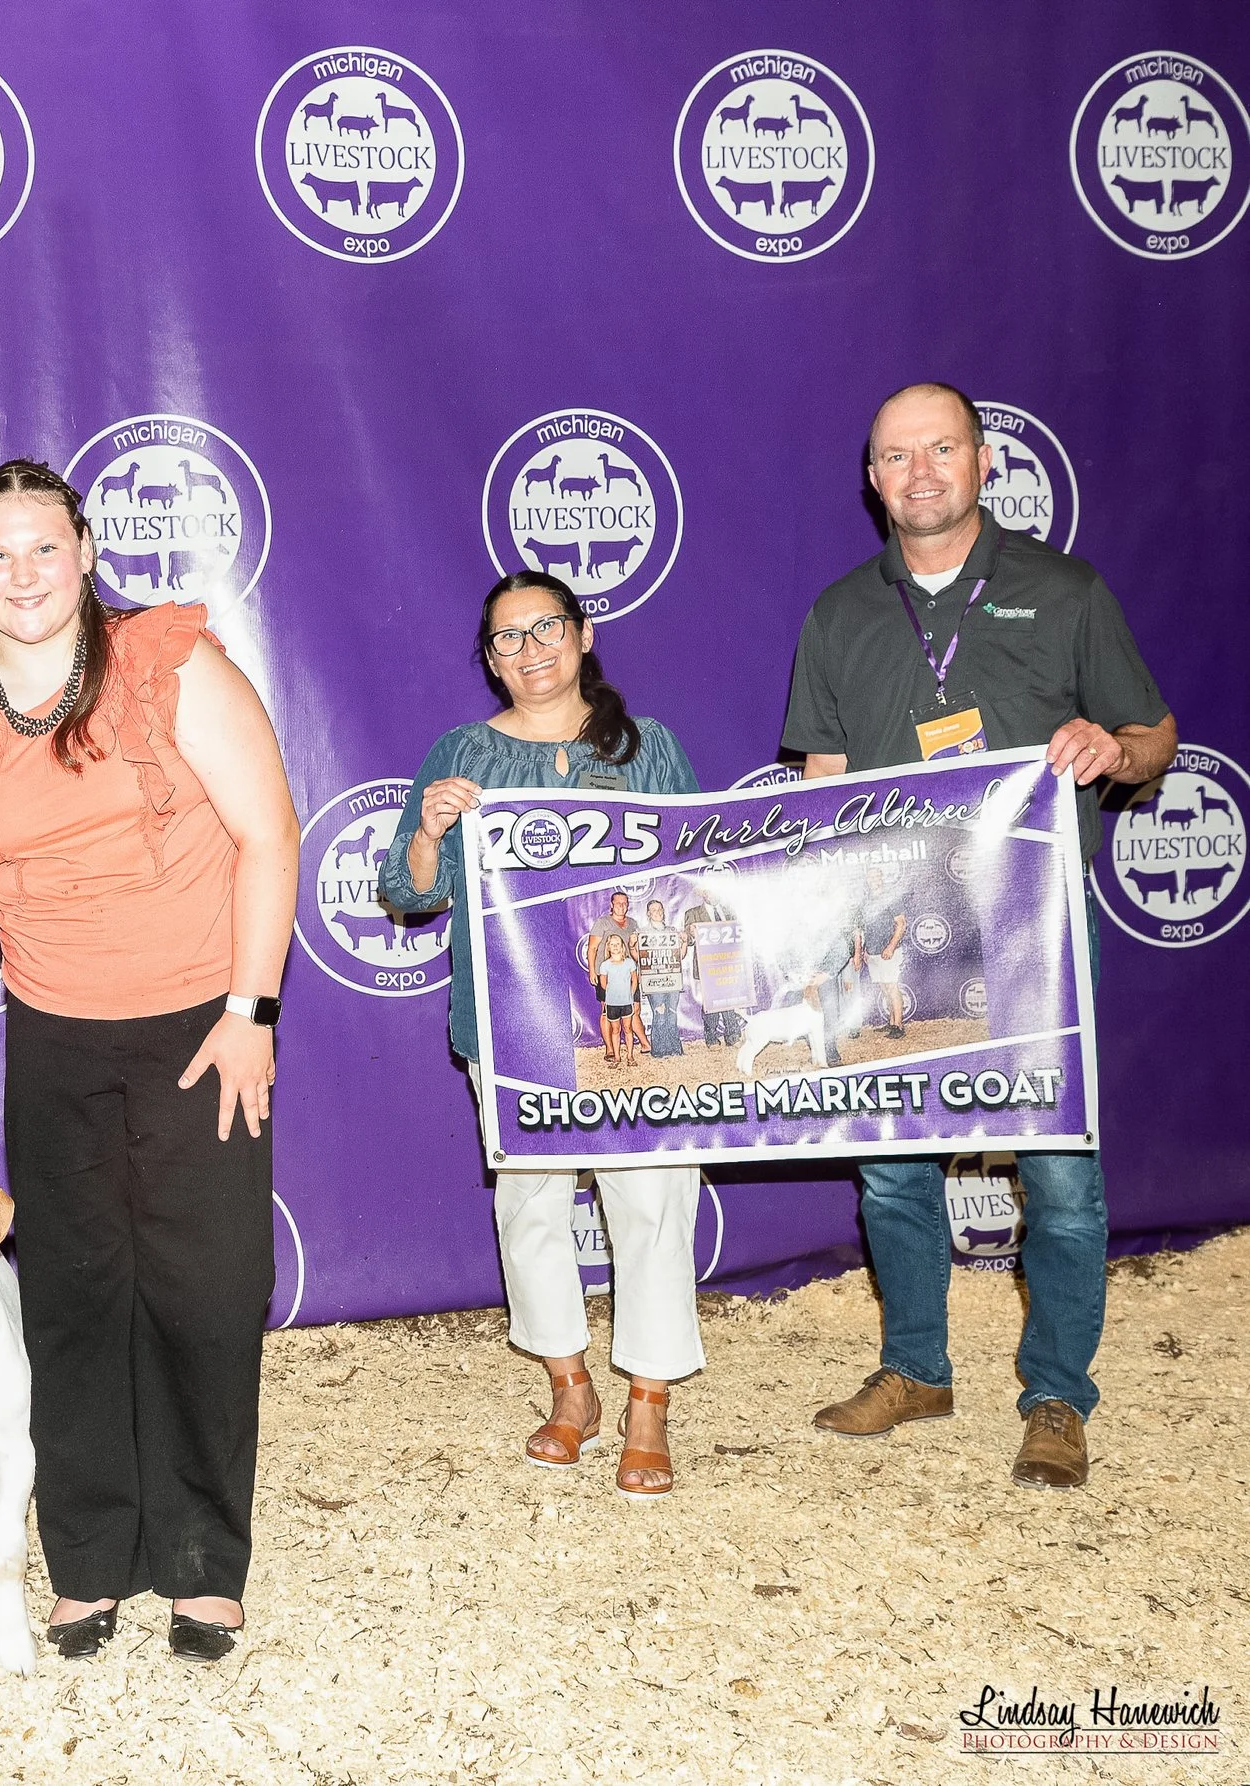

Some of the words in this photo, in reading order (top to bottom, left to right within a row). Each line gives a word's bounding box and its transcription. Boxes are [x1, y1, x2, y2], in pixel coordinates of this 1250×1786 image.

[313, 54, 404, 82] michigan
[730, 57, 817, 84] michigan
[1125, 57, 1205, 85] michigan
[290, 143, 433, 171] LIVESTOCK
[706, 146, 845, 169] LIVESTOCK
[1102, 146, 1230, 169] LIVESTOCK
[343, 234, 391, 257] expo
[755, 235, 803, 256] expo
[1146, 232, 1191, 253] expo
[113, 421, 207, 450] michigan
[536, 415, 625, 443] michigan
[512, 505, 652, 531] LIVESTOCK
[522, 835, 561, 844] LIVESTOCK
[676, 803, 822, 858] Marley
[820, 840, 926, 866] Marshall
[1116, 834, 1243, 861] LIVESTOCK
[1161, 921, 1204, 941] expo
[374, 969, 426, 991] expo
[517, 1083, 746, 1127] SHOWCASE
[757, 1073, 929, 1117] MARKET
[939, 1068, 1063, 1106] GOAT
[950, 1191, 1028, 1221] LIVEST
